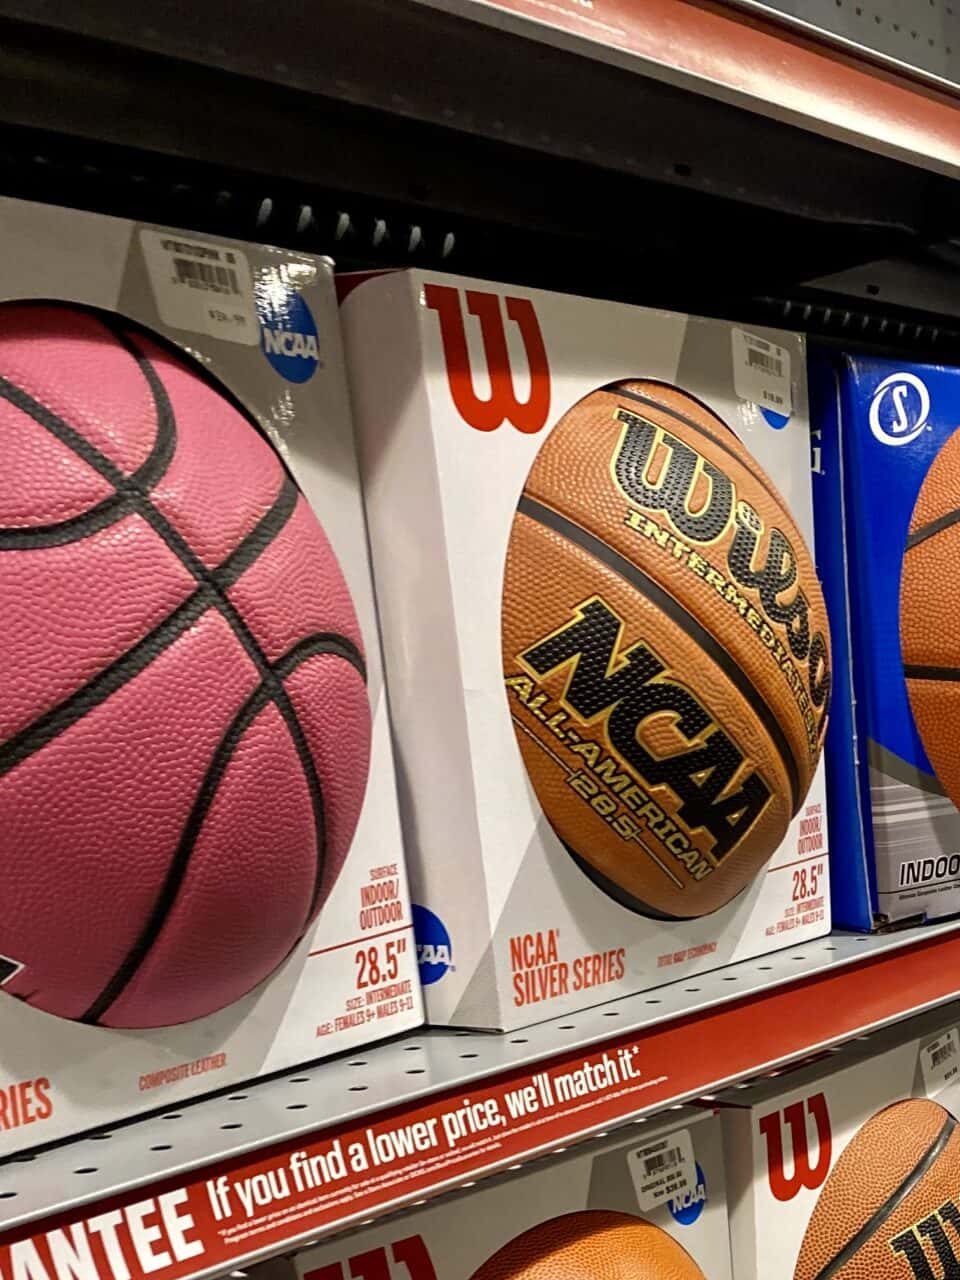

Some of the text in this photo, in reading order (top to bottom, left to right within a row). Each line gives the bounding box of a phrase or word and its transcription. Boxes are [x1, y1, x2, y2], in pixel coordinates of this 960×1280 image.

[263, 329, 319, 361] NCAA
[515, 595, 776, 870] NCAA
[504, 674, 718, 882] ALL-AMERICAN
[360, 878, 400, 908] INDOOR/
[792, 863, 824, 902] 28.5"
[359, 900, 403, 932] OUTDOOR
[355, 938, 407, 990] 28.5"
[510, 928, 558, 973] NCAA
[513, 965, 570, 1008] SILVER
[573, 948, 627, 992] SERIES
[315, 1021, 334, 1039] AGE:
[334, 1011, 365, 1033] FEMALES
[377, 1000, 398, 1021] MALES
[139, 1052, 228, 1091] COMPOSITE LEATHER
[206, 1176, 232, 1221] If
[234, 1167, 291, 1218] you
[289, 1139, 348, 1193] find
[348, 1143, 370, 1173] a
[365, 1116, 438, 1166] lower
[441, 1099, 508, 1148] price,
[504, 1072, 555, 1119] we'll
[553, 1053, 619, 1103] match
